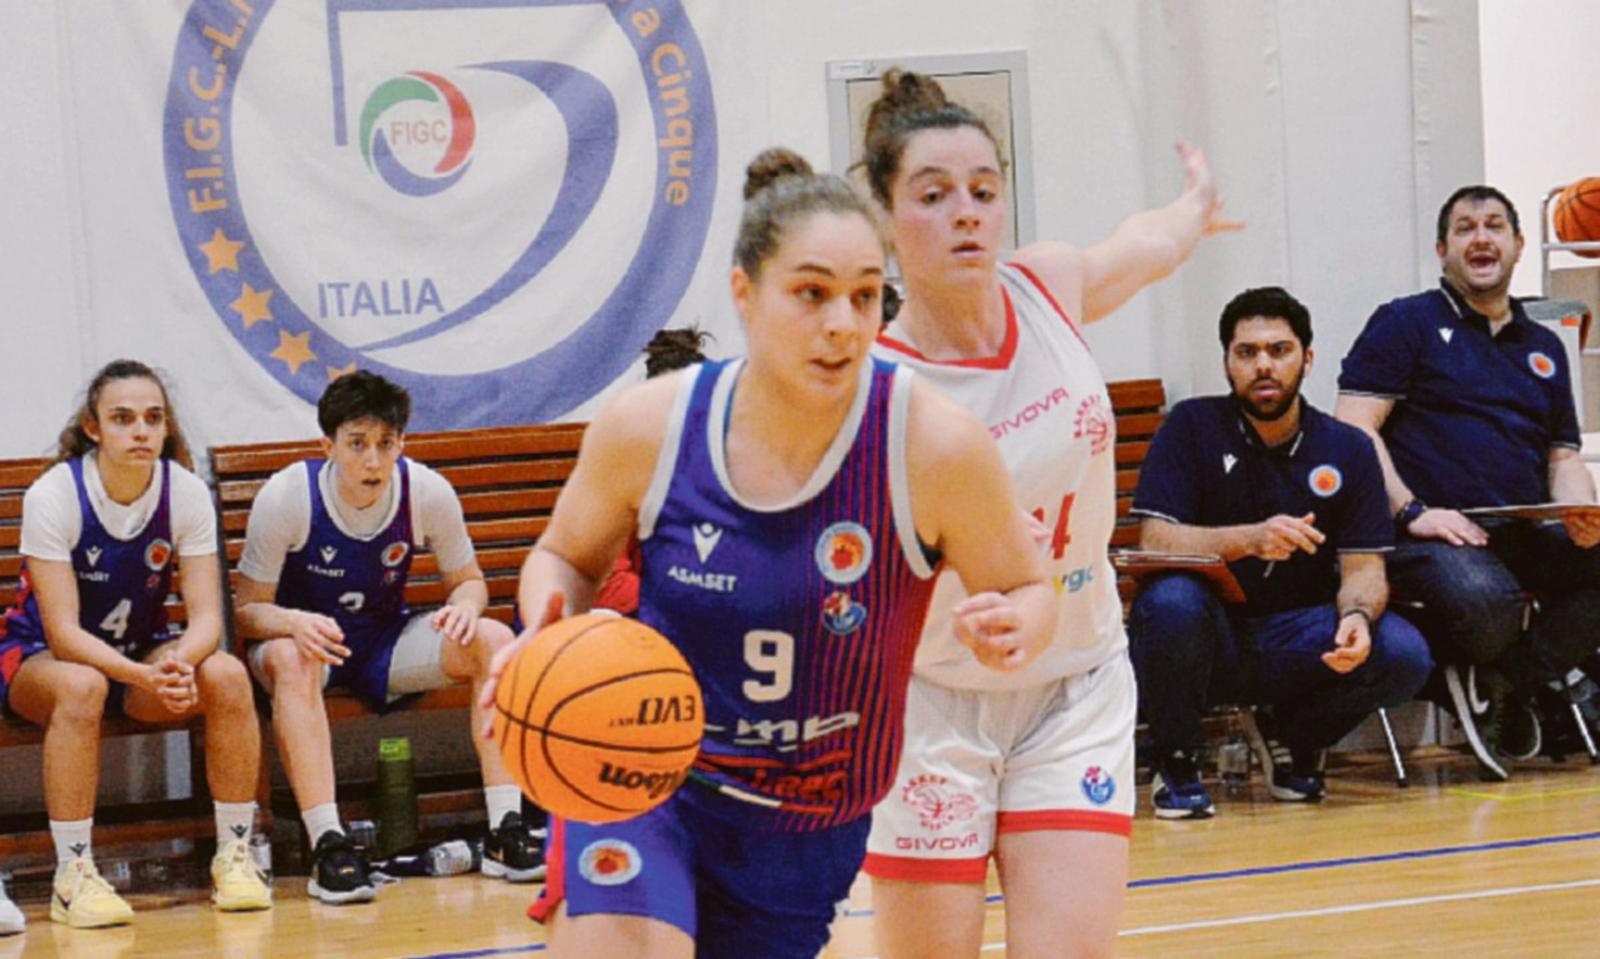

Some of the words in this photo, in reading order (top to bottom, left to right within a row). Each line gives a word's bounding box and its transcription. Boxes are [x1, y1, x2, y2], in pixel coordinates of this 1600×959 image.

[389, 119, 448, 146] FIGC
[651, 42, 694, 207] Cinque
[317, 277, 445, 319] ITALIA
[667, 565, 737, 593] ASMSET
[99, 597, 133, 640] 4
[741, 629, 795, 703] 9
[636, 694, 696, 727] EVO
[896, 832, 979, 852] GIVOVA
